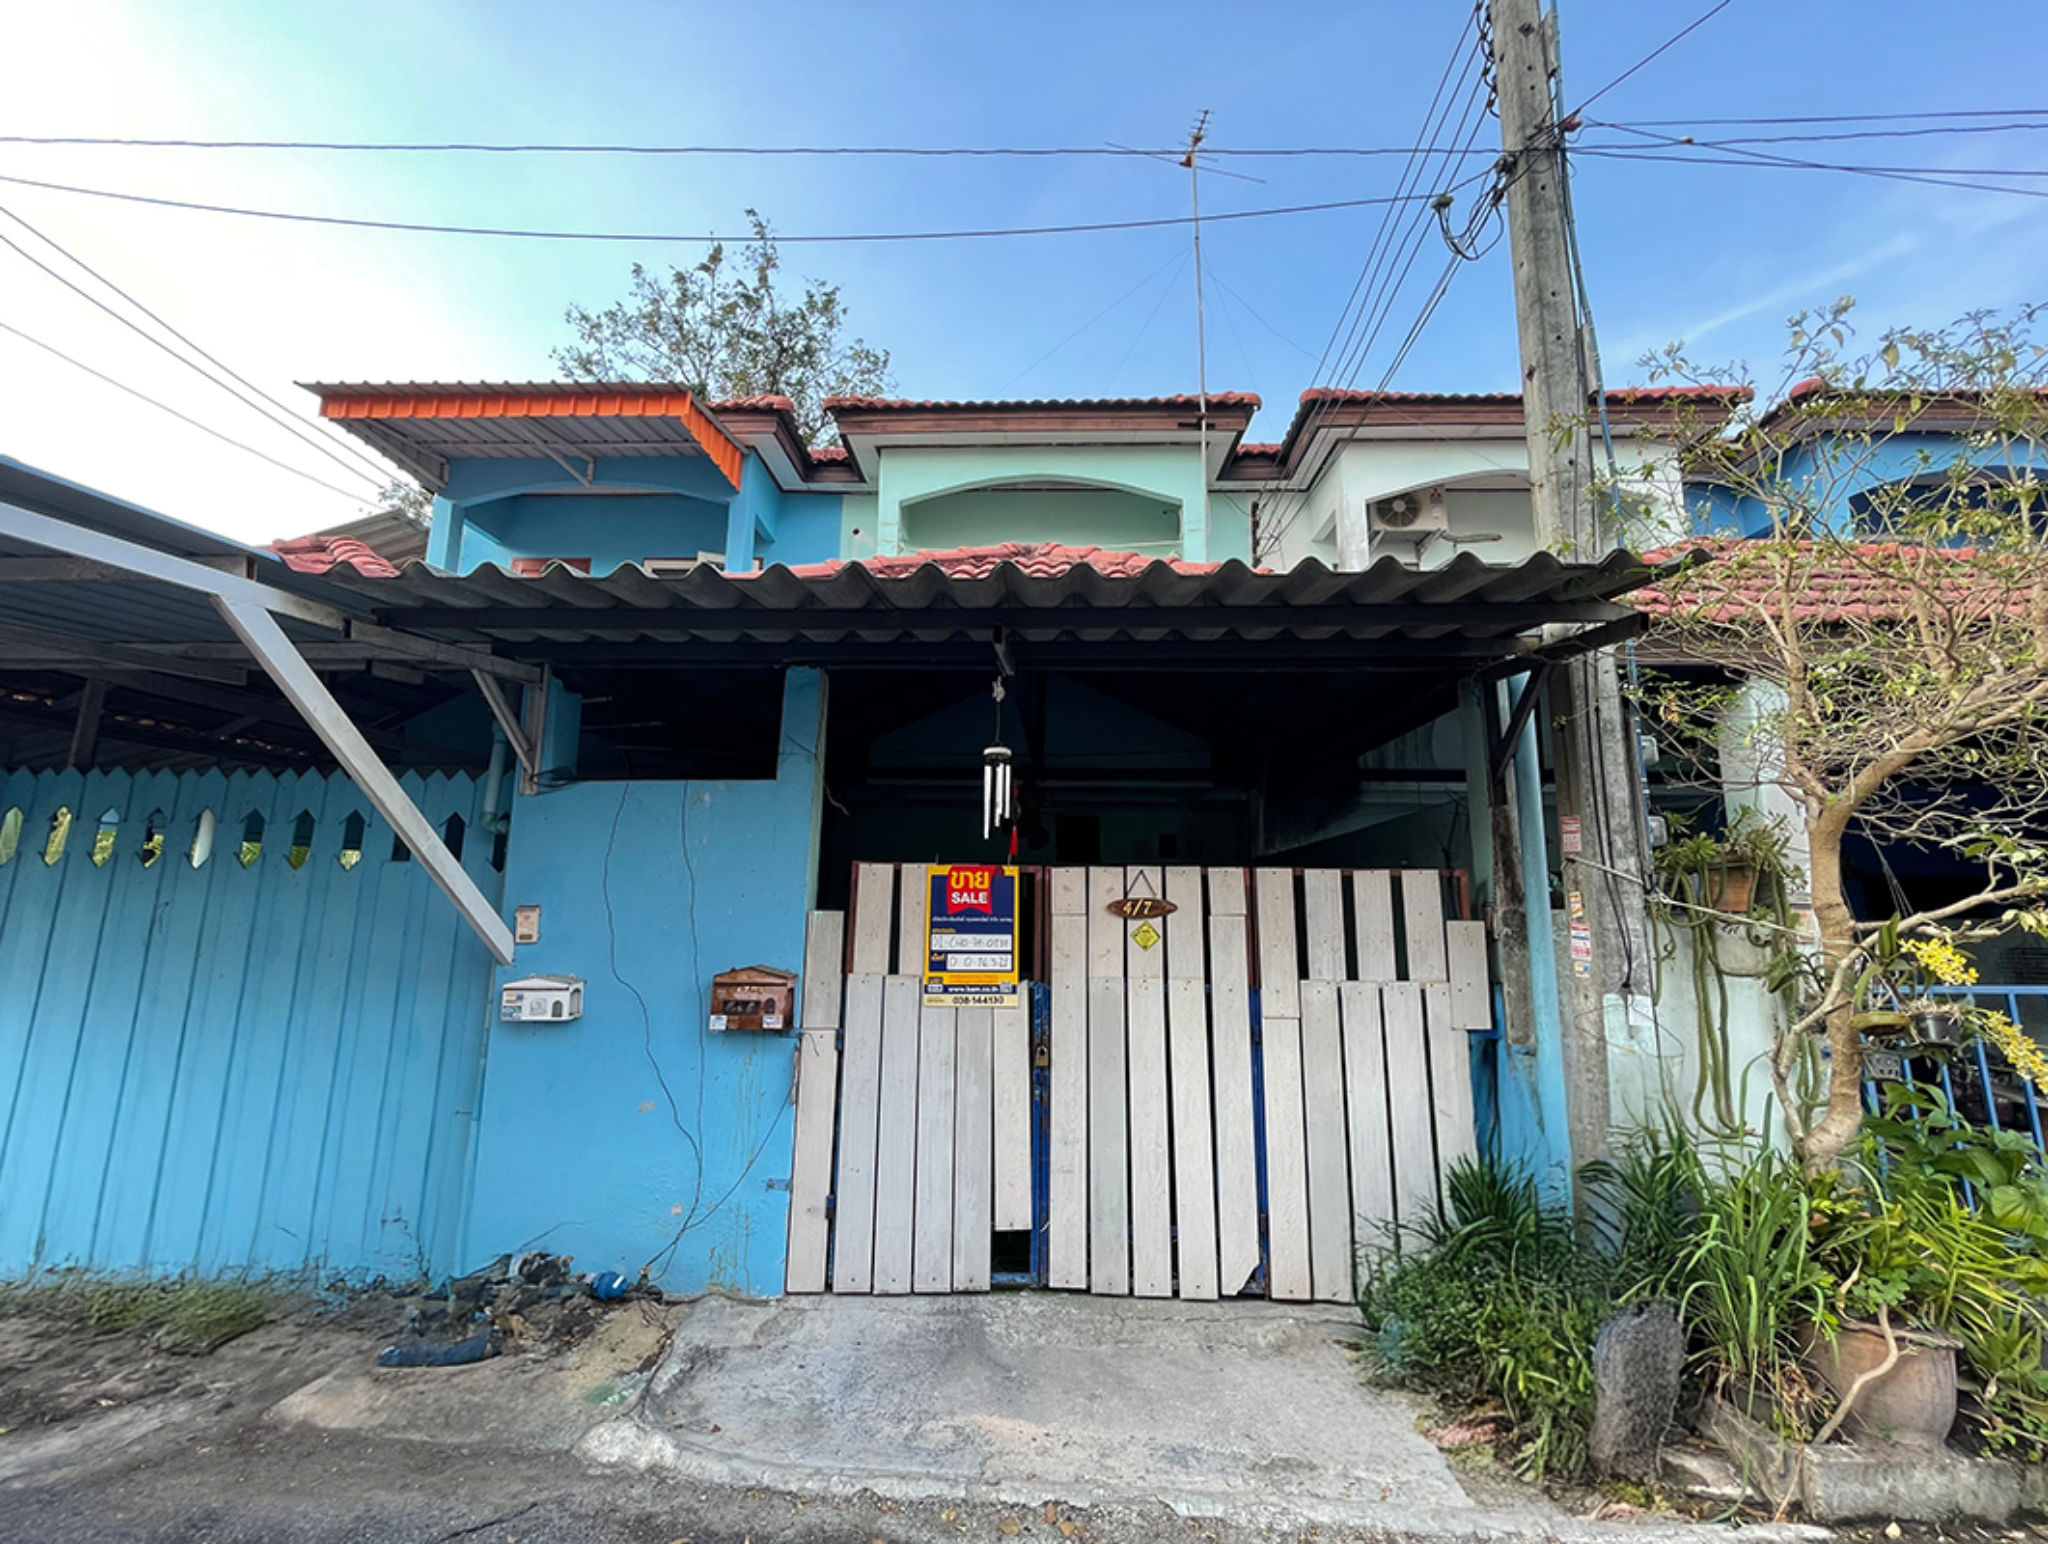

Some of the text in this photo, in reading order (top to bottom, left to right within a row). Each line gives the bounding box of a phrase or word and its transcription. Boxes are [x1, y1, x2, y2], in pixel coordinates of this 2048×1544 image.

[951, 871, 989, 889] ขาย
[951, 891, 988, 905] SALE
[1123, 899, 1153, 916] 4/7
